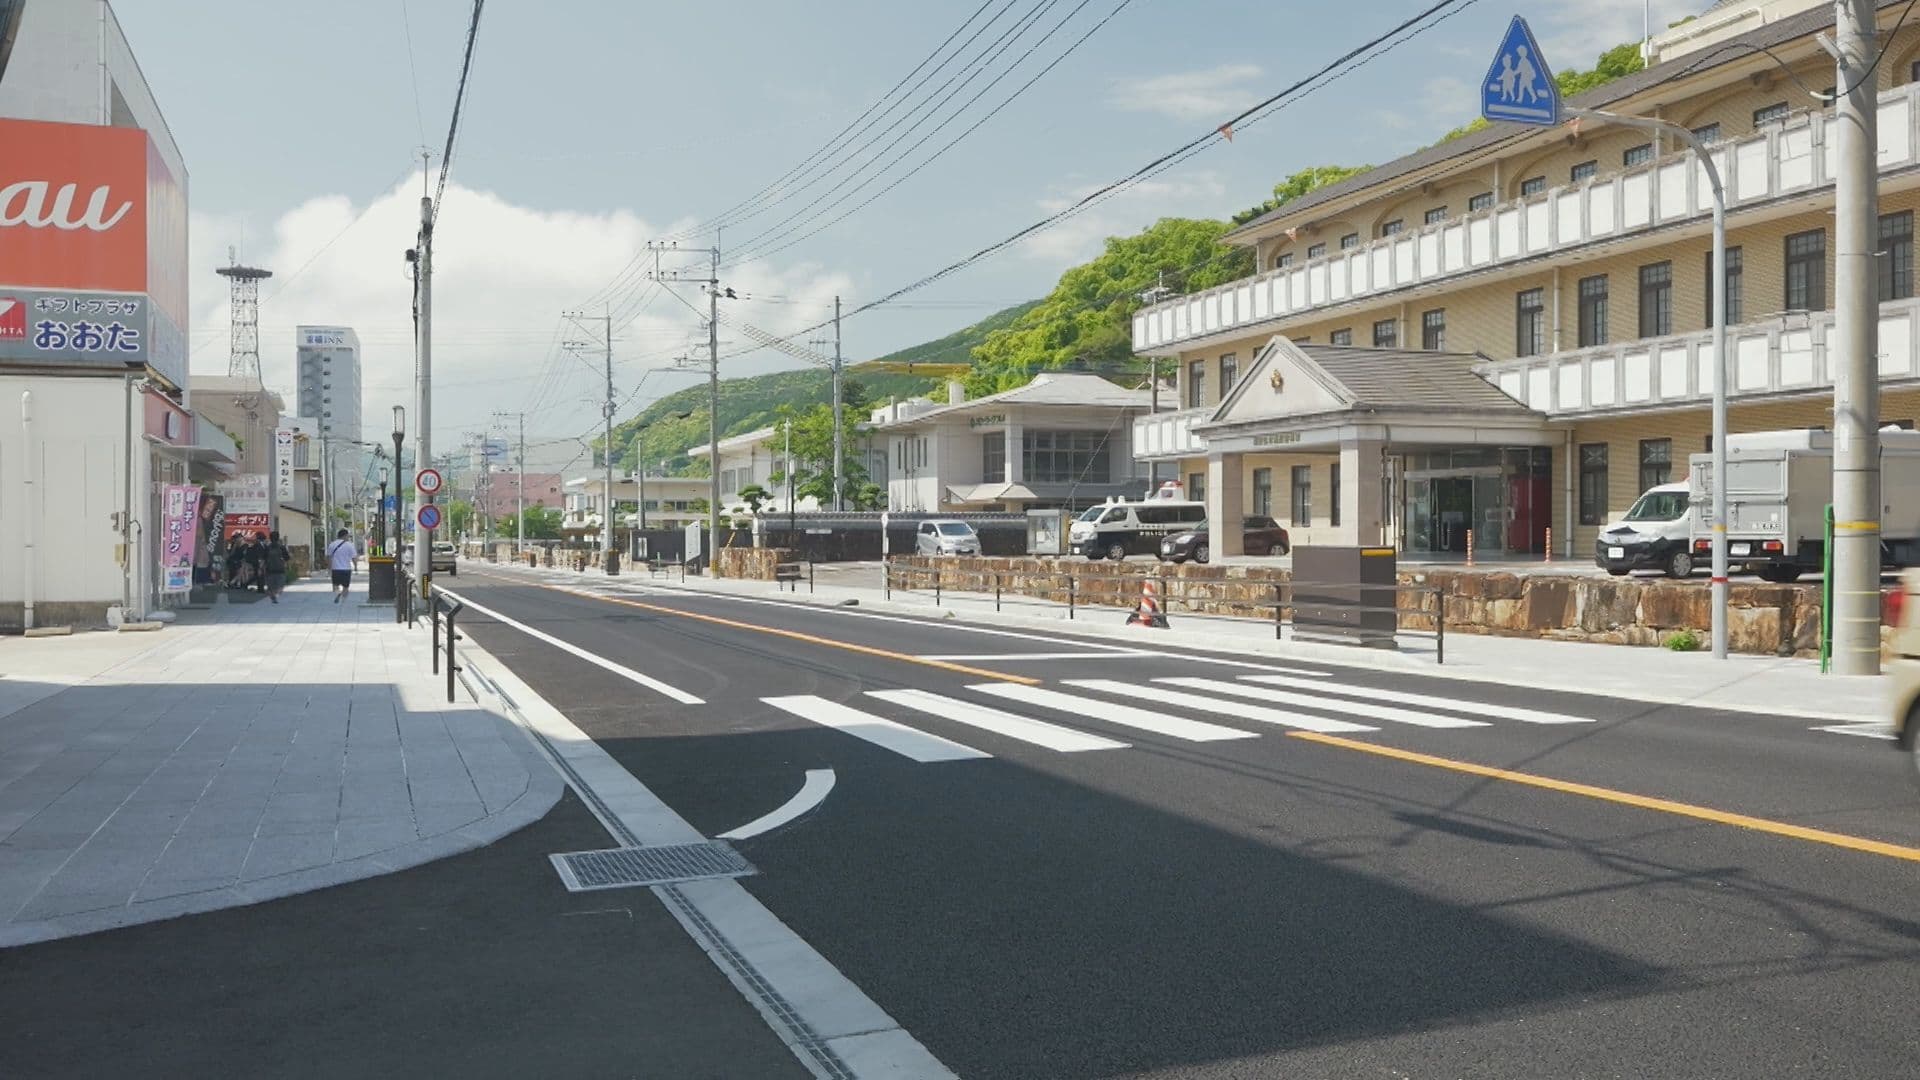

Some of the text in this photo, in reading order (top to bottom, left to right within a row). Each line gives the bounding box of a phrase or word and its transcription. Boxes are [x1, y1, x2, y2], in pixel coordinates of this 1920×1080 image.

[0, 181, 133, 231] au
[35, 296, 139, 316] ギフトプラザ
[34, 320, 140, 352] おおた
[422, 475, 436, 487] 40
